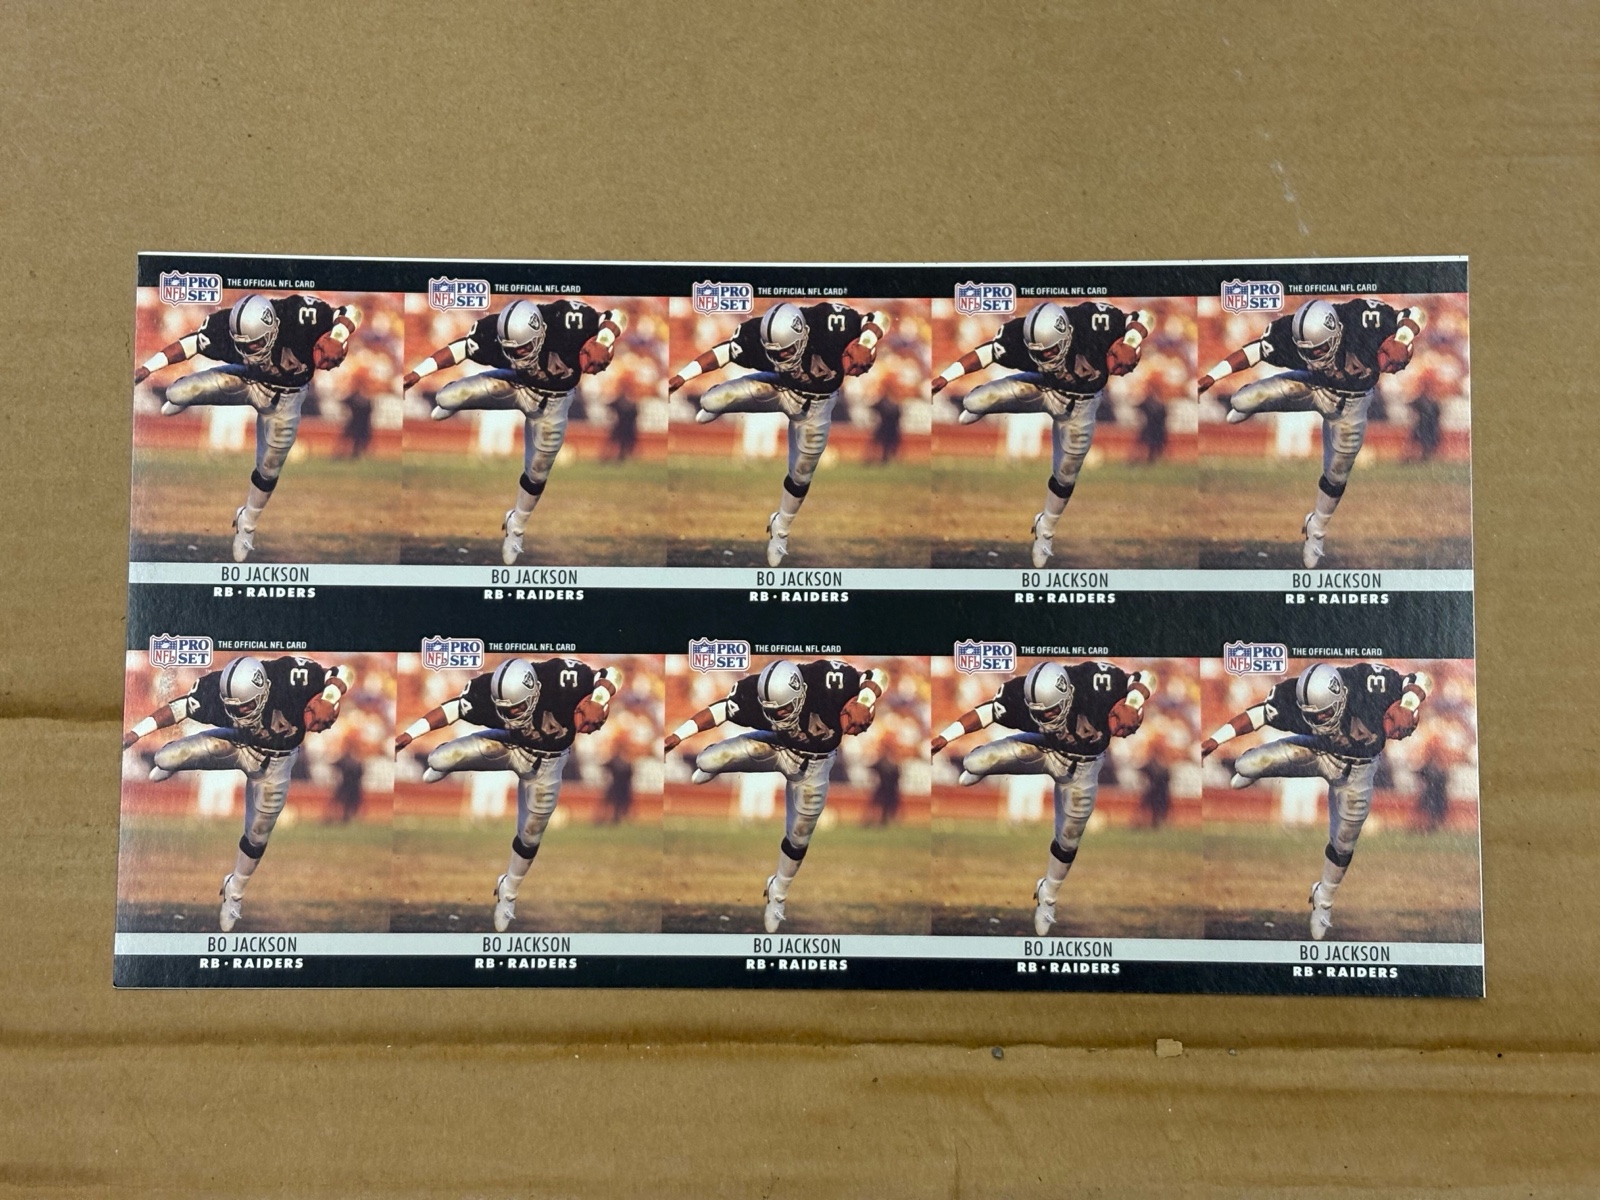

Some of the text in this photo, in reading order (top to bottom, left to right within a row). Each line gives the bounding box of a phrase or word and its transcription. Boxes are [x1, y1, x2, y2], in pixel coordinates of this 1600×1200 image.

[188, 277, 219, 288] PRO
[227, 278, 316, 288] THE OFFICIAL NFL CARD
[457, 282, 487, 293] PRO
[495, 284, 581, 293] THE OFFICIAL NFL CARD
[1288, 283, 1378, 293] THE OFFICIAL NFL CARD
[165, 287, 186, 300] NFL
[720, 286, 750, 297] PRO
[758, 287, 772, 295] THE
[773, 287, 807, 295] OFFICIAL
[807, 287, 822, 296] NFL
[983, 286, 1013, 297] PRO
[1020, 287, 1108, 295] THE OFFICIAL NFL CARD
[1250, 284, 1280, 295] PRO
[188, 290, 218, 302] SET
[434, 292, 454, 305] NFL
[457, 296, 486, 307] SET
[1227, 295, 1247, 308] NFL
[698, 296, 718, 309] NFL
[720, 299, 749, 310] SET
[960, 297, 980, 310] NFL
[983, 300, 1012, 311] SET
[1250, 297, 1280, 309] SET
[222, 566, 309, 583] BO JACKSON
[492, 569, 578, 585] BO JACKSON
[757, 571, 842, 587] BO JACKSON
[1022, 572, 1109, 588] BO JACKSON
[1293, 572, 1382, 589] BO JACKSON
[214, 587, 316, 598] RB RAIDERS
[484, 589, 584, 601] RB RAIDERS
[749, 591, 849, 603] RB RAIDERS
[1014, 593, 1116, 604] RB RAIDERS
[1285, 593, 1389, 605] RB RAIDERS
[180, 639, 210, 650] PRO
[218, 640, 308, 649] THE OFFICIAL NFL CARD
[451, 641, 481, 652] PRO
[489, 642, 576, 651] THE OFFICIAL NFL CARD
[717, 643, 747, 654] PRO
[755, 644, 842, 653] THE OFFICIAL NFL CARD
[983, 645, 1013, 656] PRO
[1021, 646, 1109, 655] THE OFFICIAL NFL CARD
[156, 649, 177, 663] NFL
[1253, 646, 1284, 657] PRO
[1292, 647, 1383, 656] THE OFFICIAL NFL CARD
[179, 652, 209, 664] SET
[428, 652, 448, 665] NFL
[450, 655, 480, 666] SET
[695, 654, 715, 667] NFL
[717, 657, 746, 668] SET
[960, 655, 980, 668] NFL
[983, 658, 1012, 670] SET
[1230, 657, 1251, 670] NFL
[1253, 660, 1284, 671] SET
[208, 936, 297, 953] BO JACKSON
[483, 936, 571, 953] BO JACKSON
[754, 937, 841, 954] BO JACKSON
[1024, 940, 1113, 958] BO JACKSON
[1300, 944, 1390, 962] BO JACKSON
[199, 957, 304, 969] RB RAIDERS
[475, 957, 578, 969] RB RAIDERS
[746, 959, 848, 971] RB RAIDERS
[1017, 962, 1120, 974] RB RAIDERS
[1292, 966, 1398, 978] RB RAIDERS
